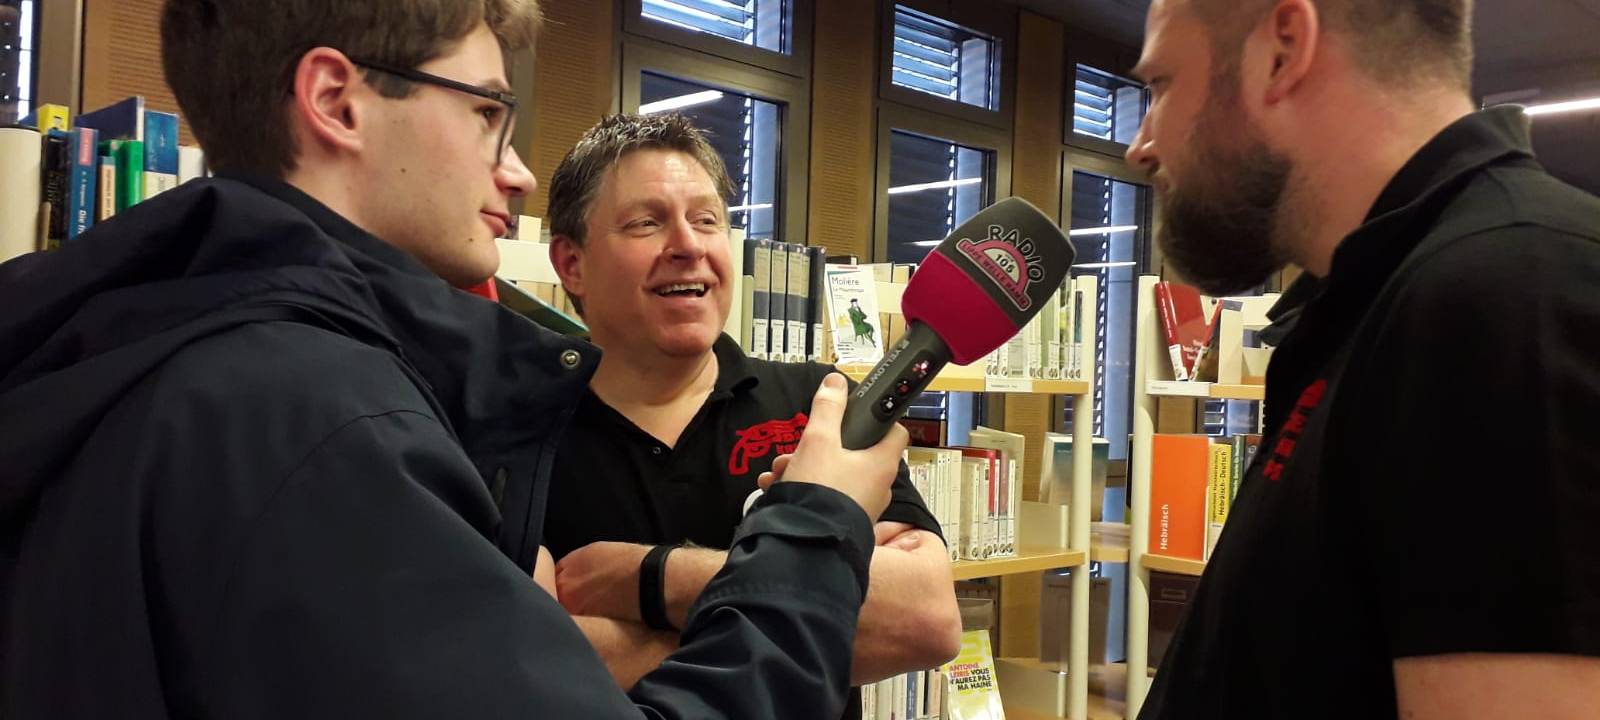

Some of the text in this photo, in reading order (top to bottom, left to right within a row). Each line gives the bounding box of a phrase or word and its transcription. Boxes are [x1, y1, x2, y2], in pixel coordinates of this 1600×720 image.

[989, 225, 1043, 282] RADIO
[995, 253, 1014, 274] 105
[857, 350, 901, 398] YELLOWTEC
[1219, 450, 1228, 478] Deutsch
[1219, 482, 1227, 515] Hebräisch
[1159, 503, 1169, 551] Hebräisch
[957, 681, 992, 691] MA HAINE
